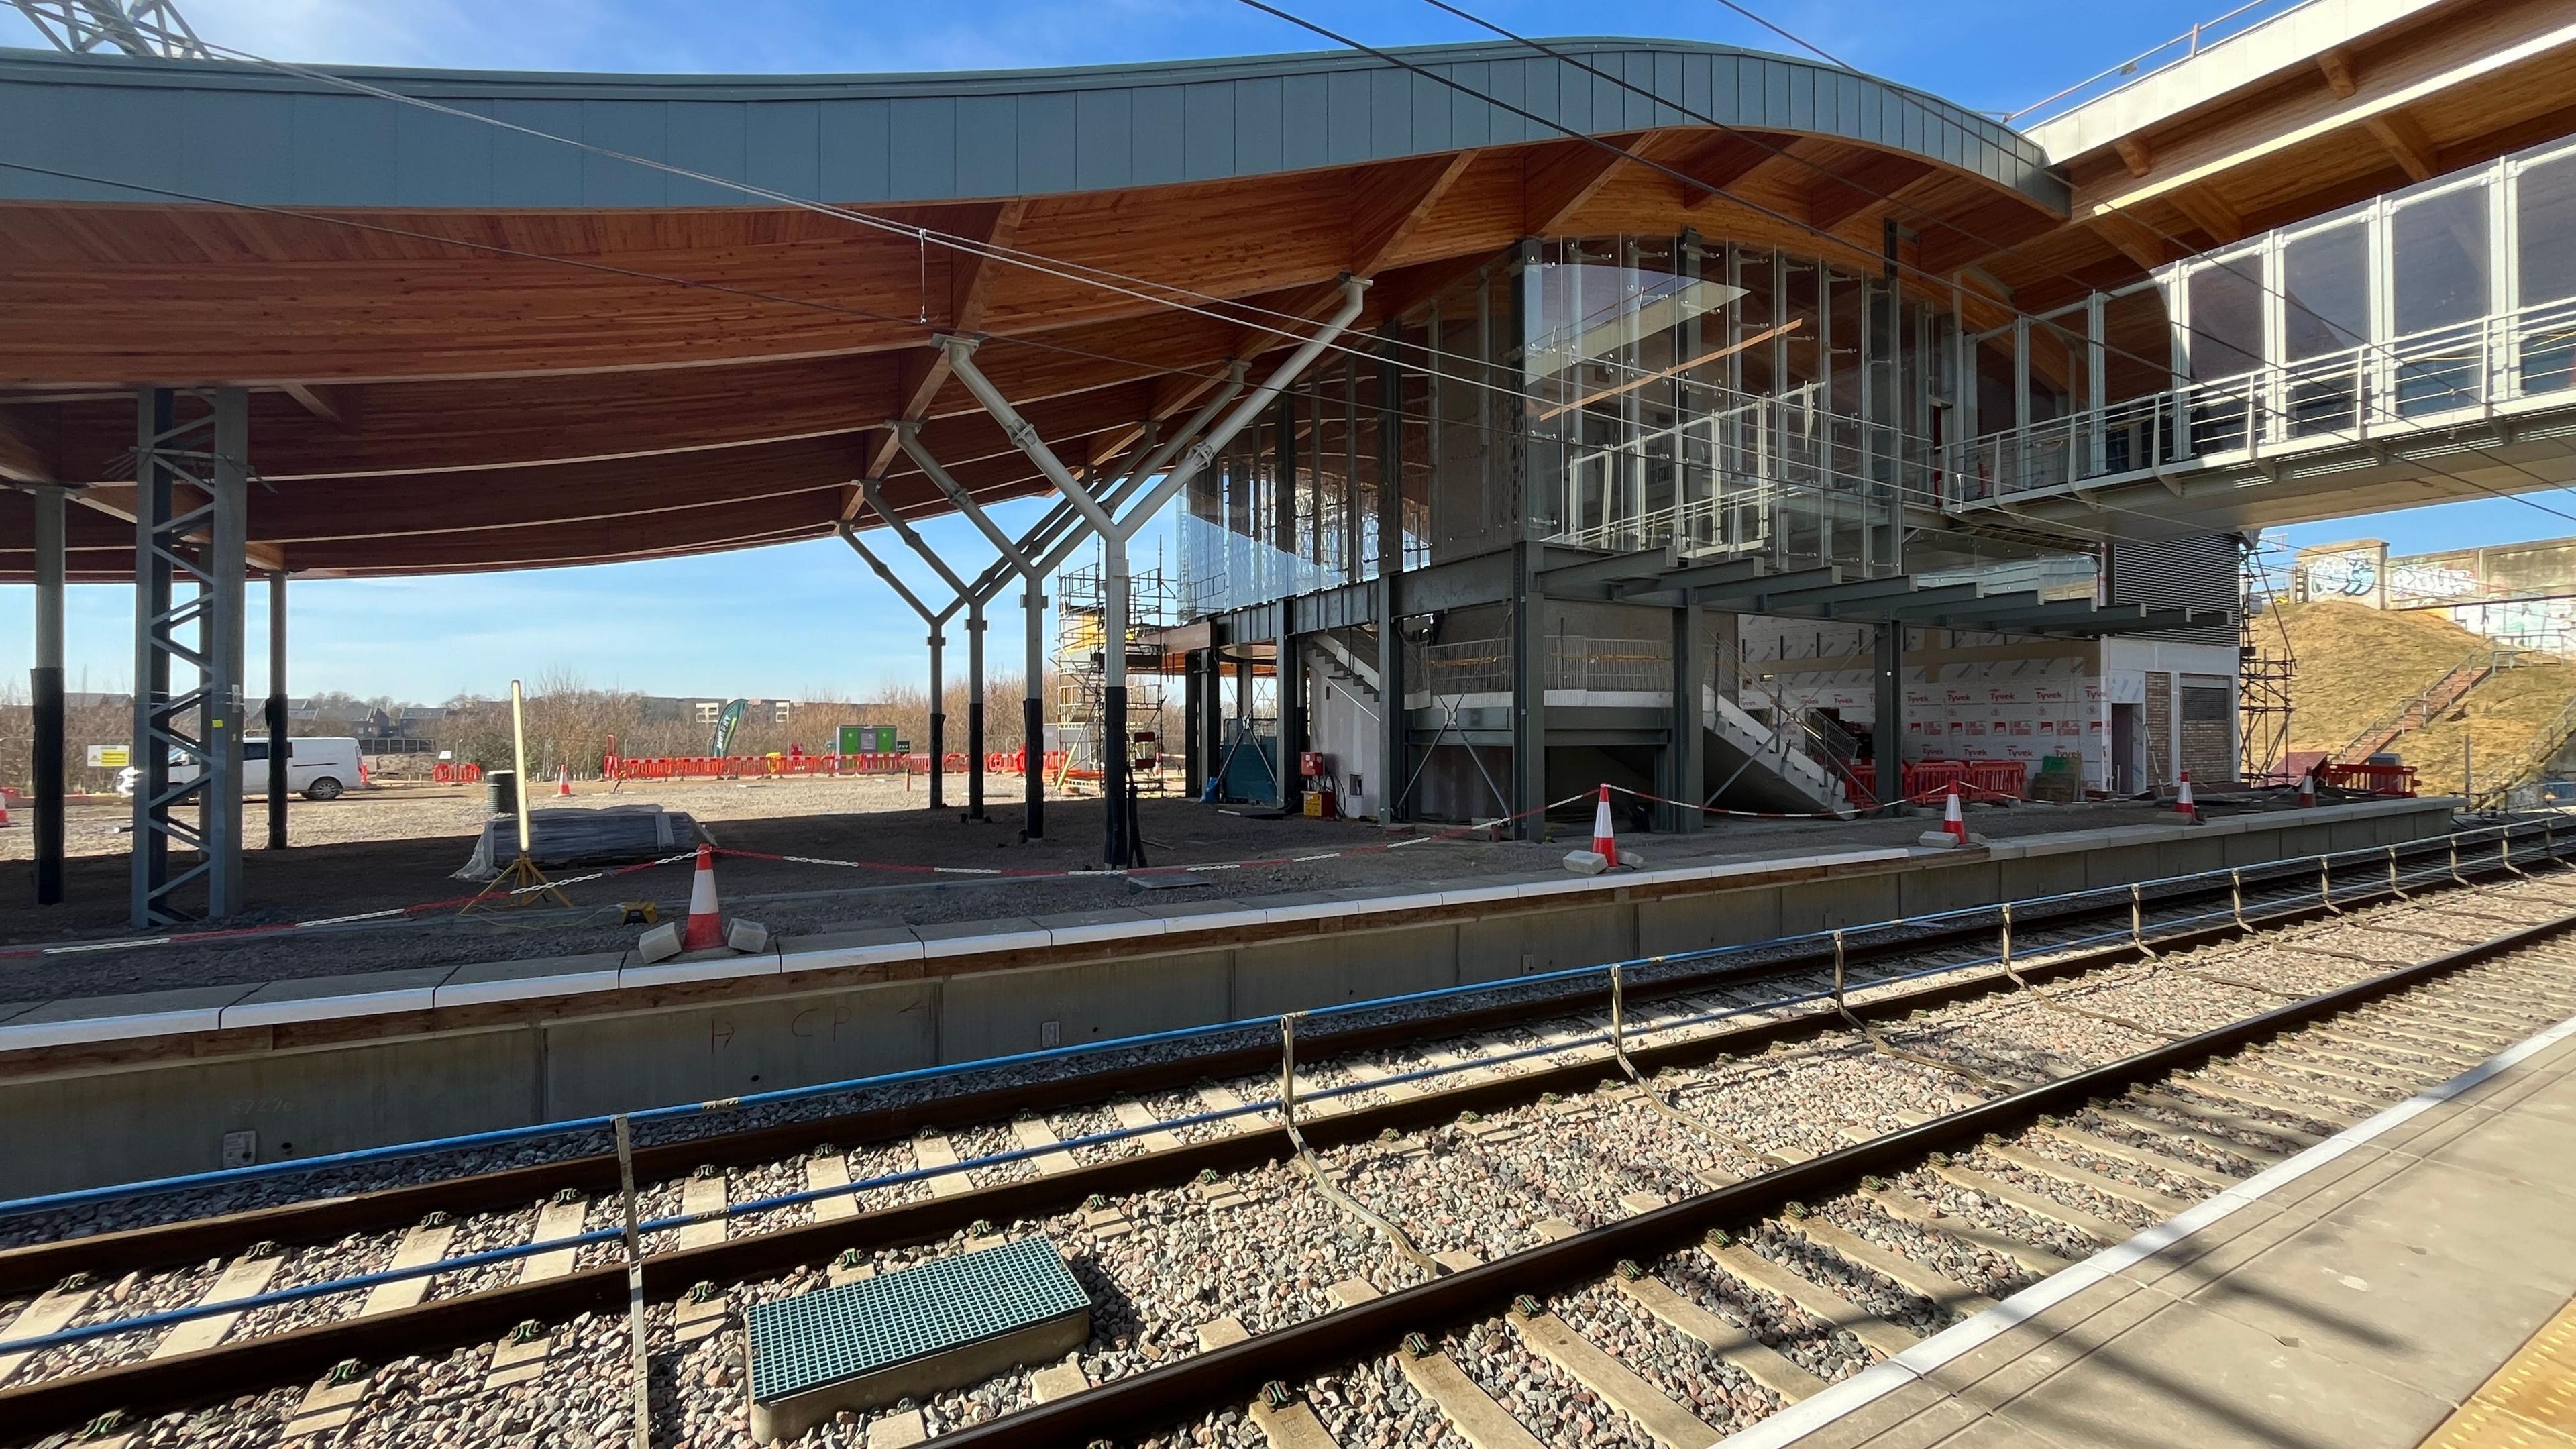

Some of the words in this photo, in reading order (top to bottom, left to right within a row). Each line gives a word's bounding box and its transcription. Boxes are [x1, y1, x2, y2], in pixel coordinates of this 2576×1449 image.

[1907, 695, 1929, 703] Tyvek
[1947, 694, 1971, 702] Tyvek
[1990, 692, 2015, 701] Tyvek
[2036, 691, 2063, 700] Tyvek
[1922, 747, 1944, 756] Tyvek
[1964, 748, 1987, 757] Tyvek
[2007, 749, 2033, 757] Tyvek
[2055, 749, 2082, 757] Tyvek
